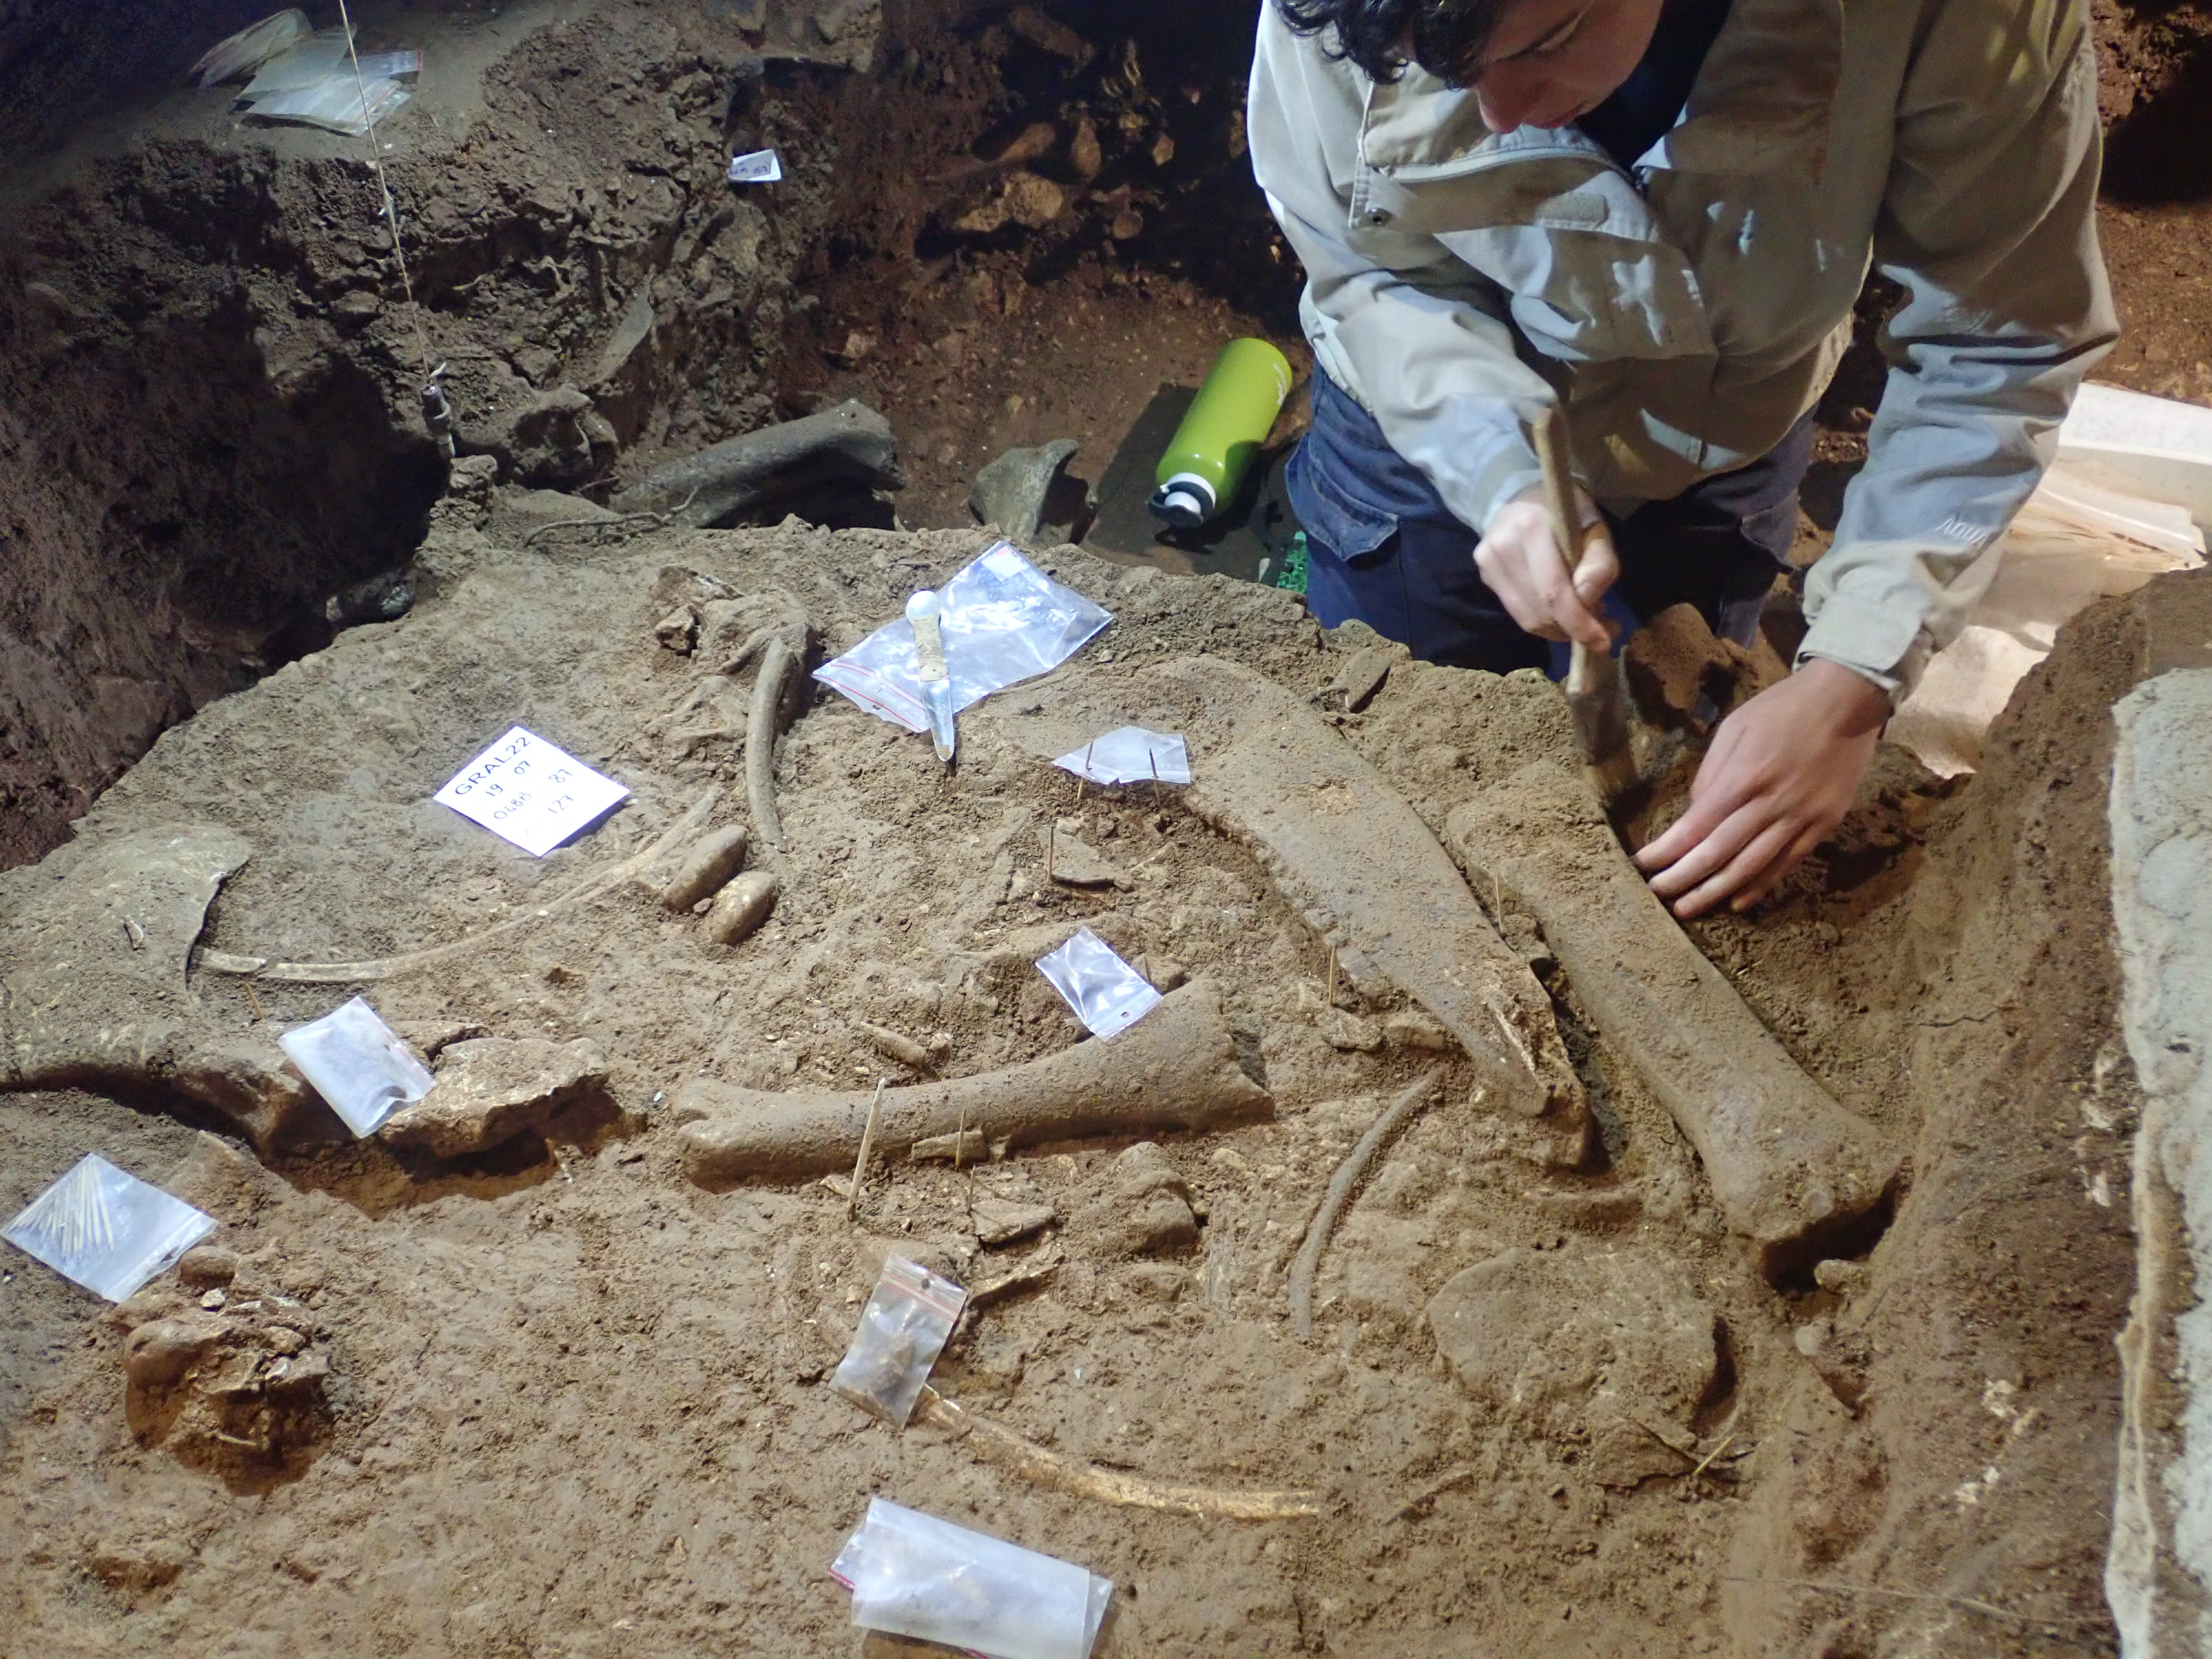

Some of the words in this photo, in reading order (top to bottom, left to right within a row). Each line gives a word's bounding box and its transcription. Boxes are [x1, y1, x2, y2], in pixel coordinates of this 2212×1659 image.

[455, 737, 531, 795] GRAL22
[486, 784, 504, 797] 19
[514, 760, 531, 775] 07
[547, 795, 575, 814] 127
